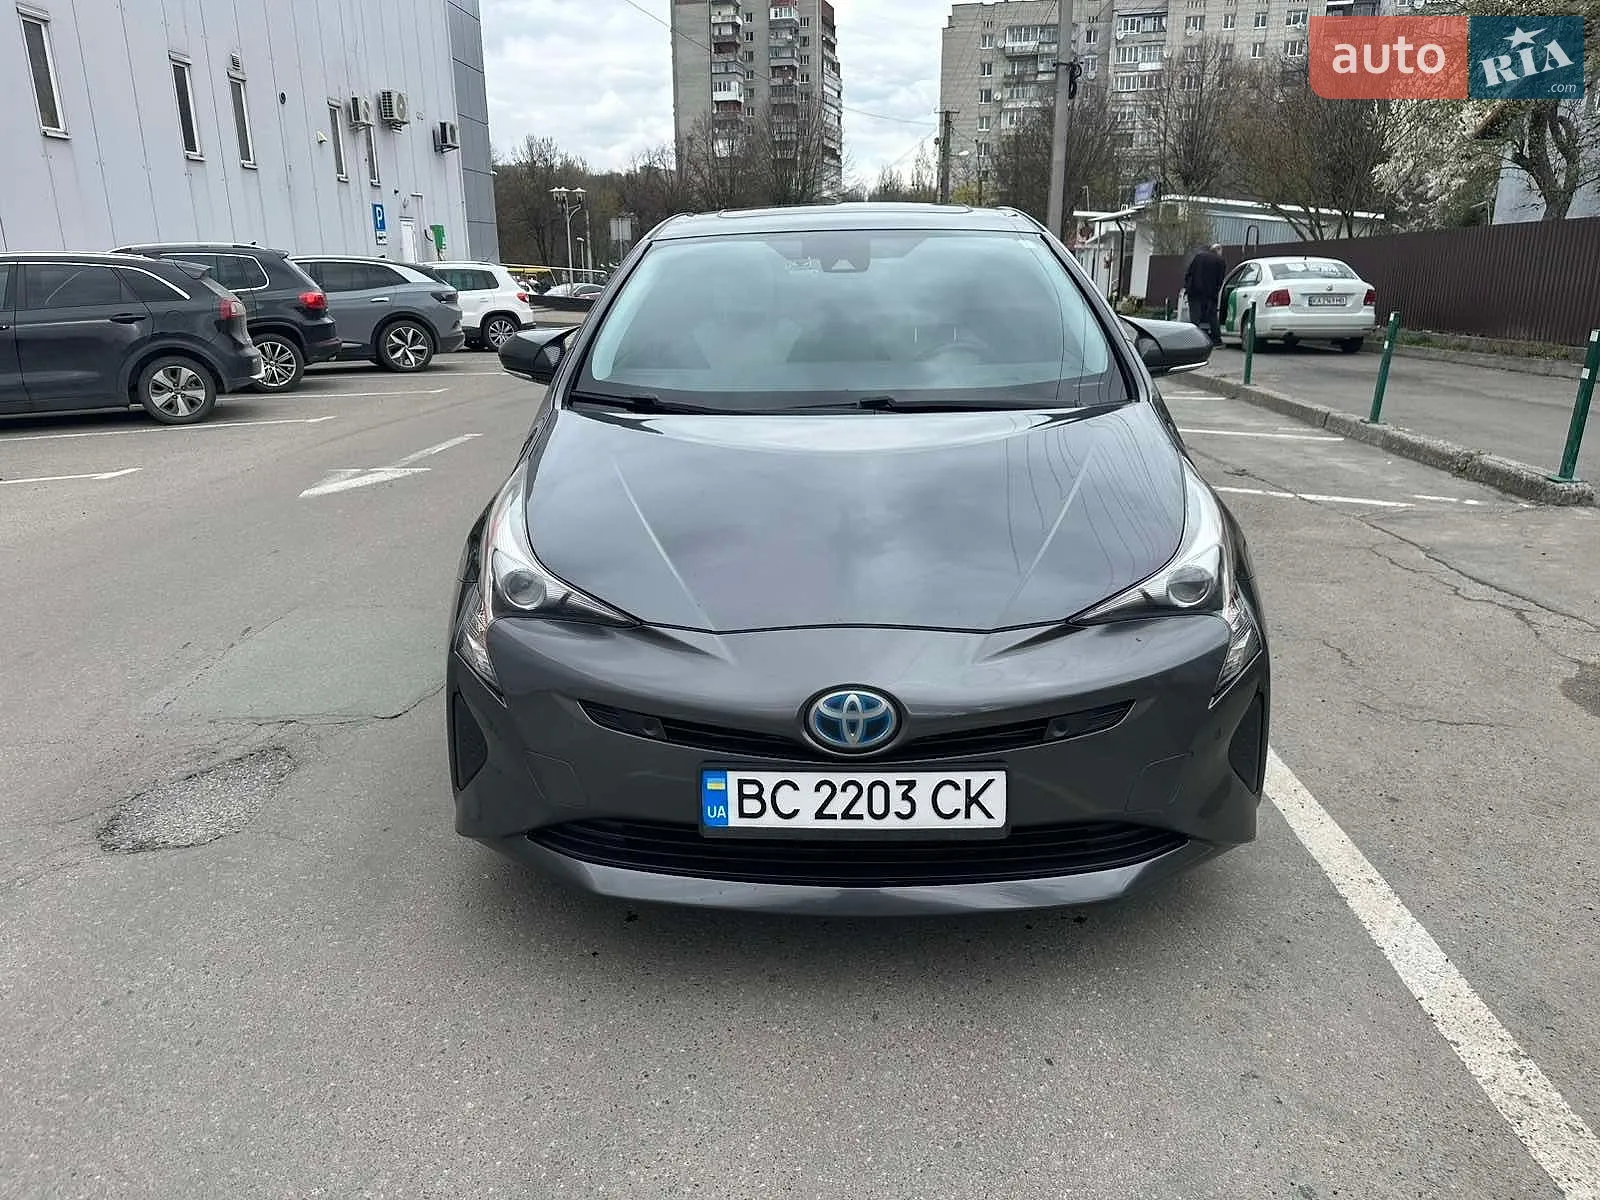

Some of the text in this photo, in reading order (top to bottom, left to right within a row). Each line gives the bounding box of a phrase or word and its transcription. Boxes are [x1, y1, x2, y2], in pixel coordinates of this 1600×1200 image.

[375, 206, 383, 228] P
[737, 778, 996, 820] BC 2203 CK
[707, 805, 727, 819] UA
